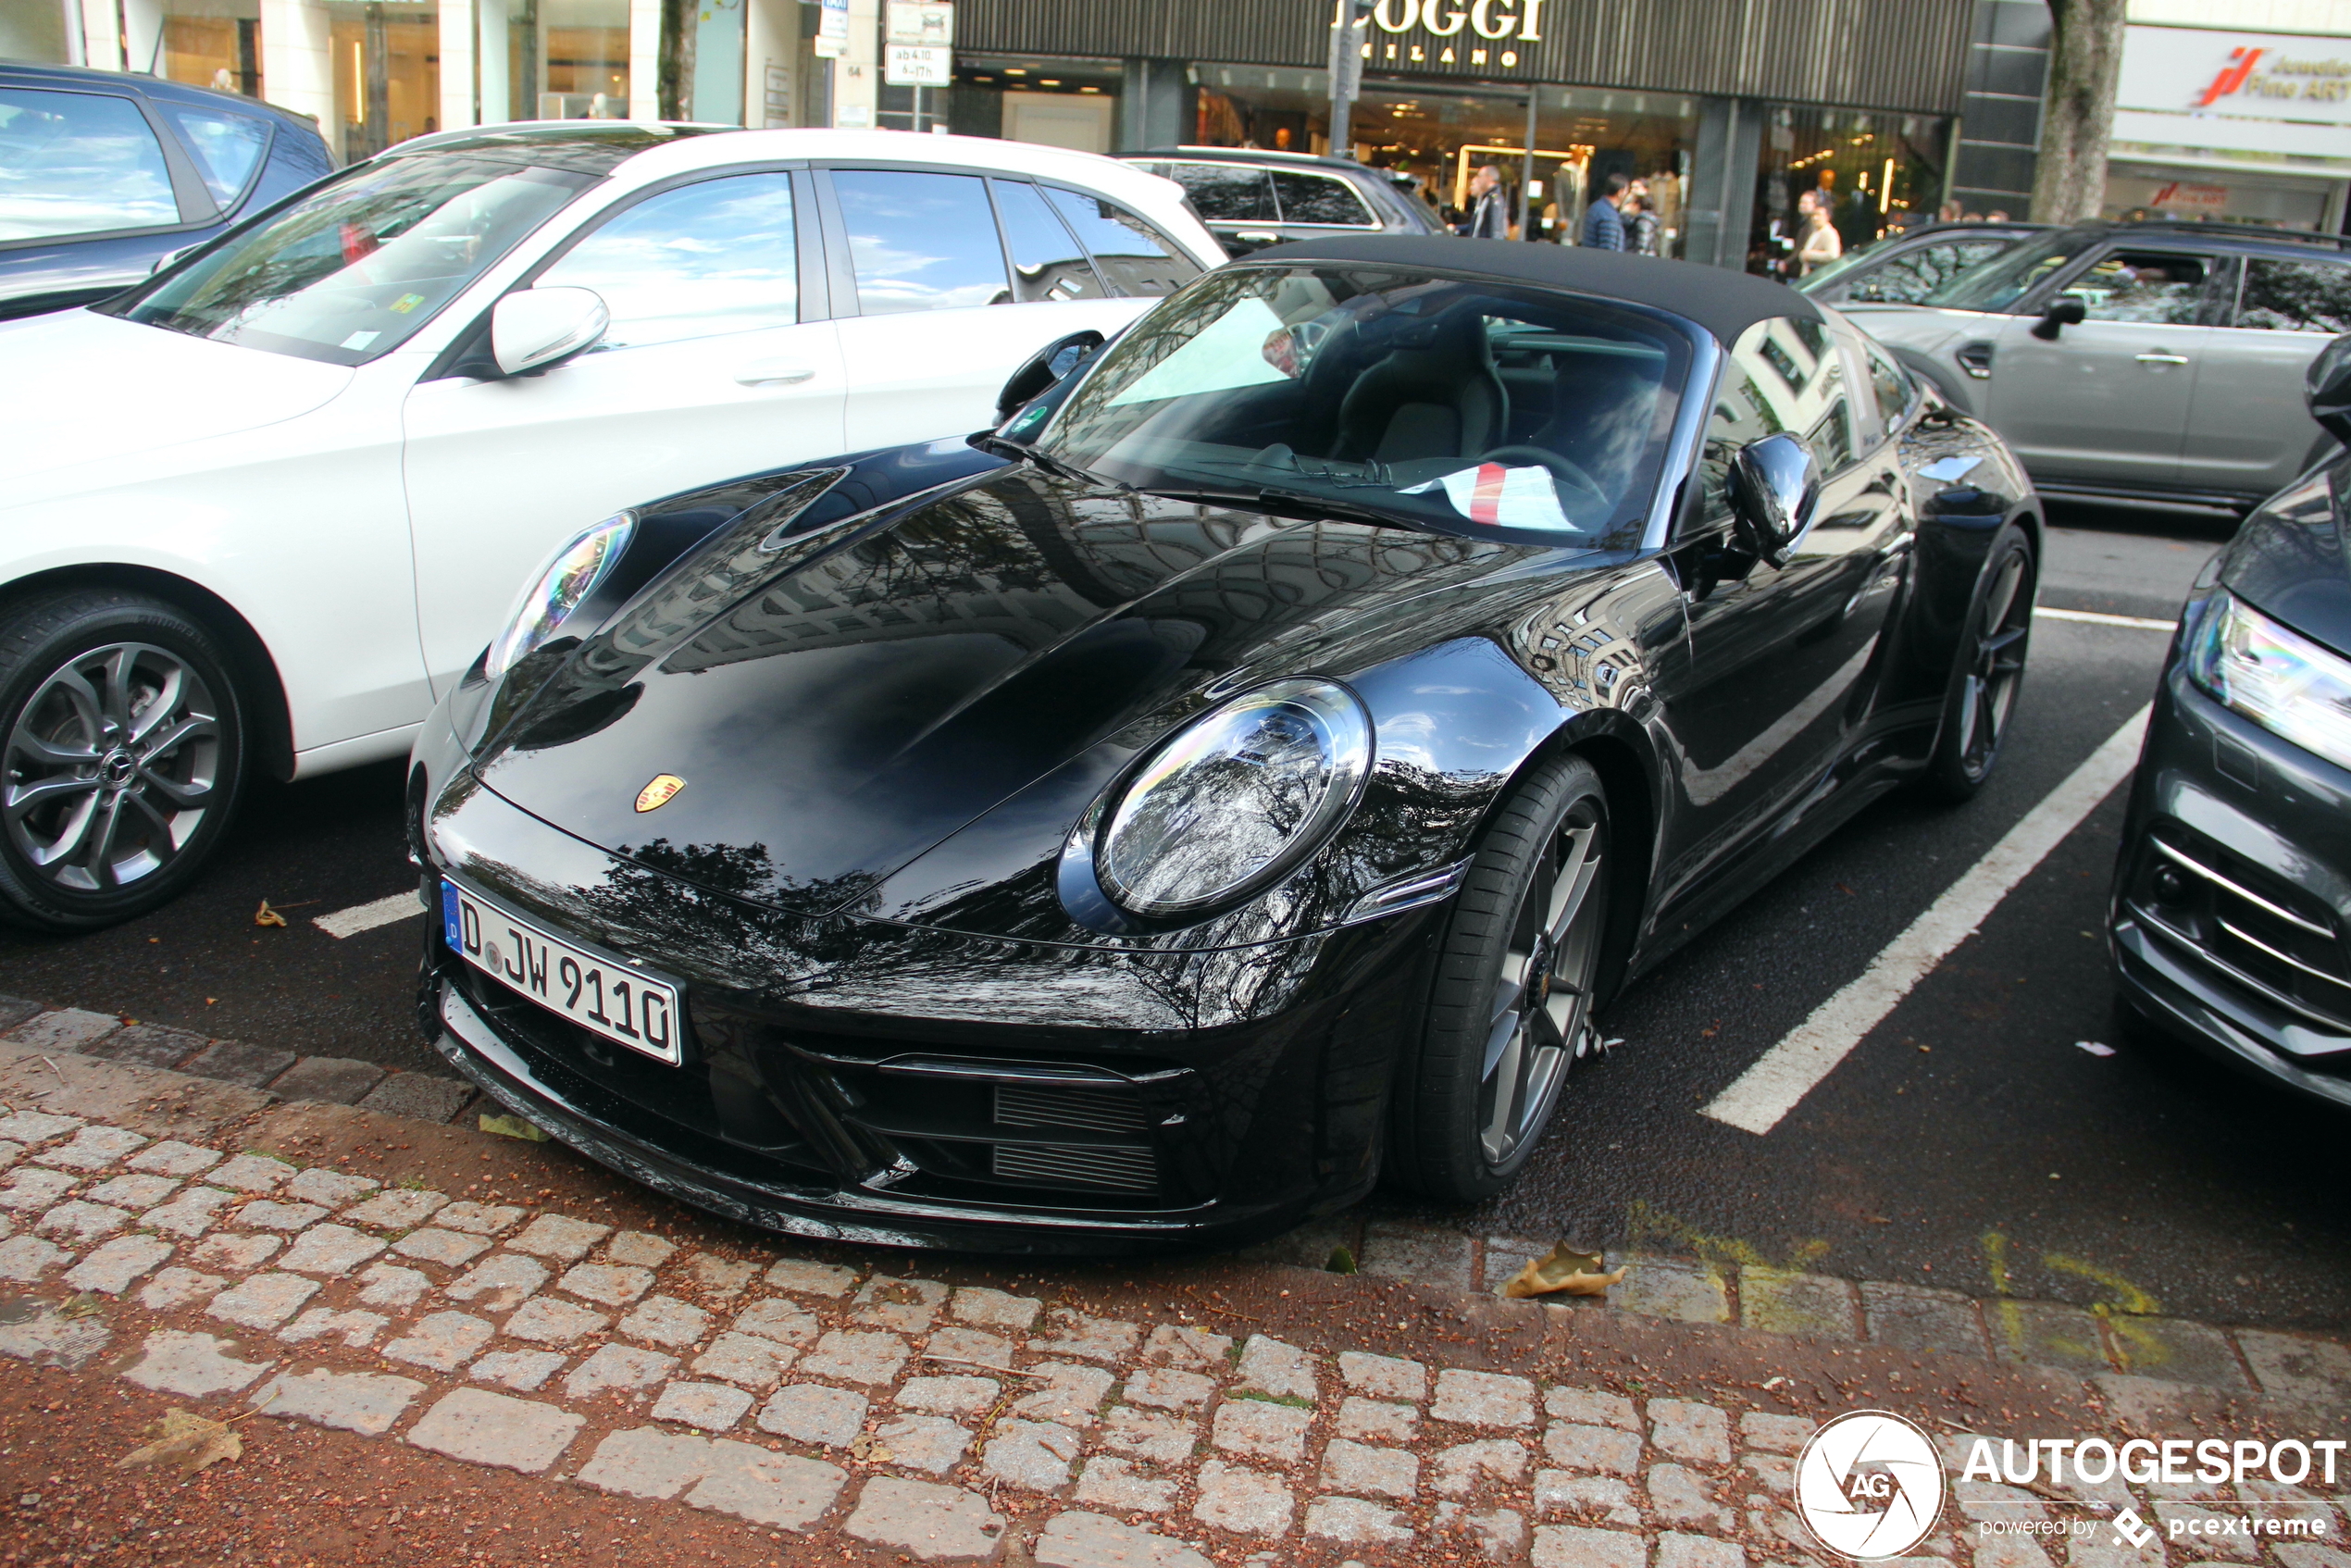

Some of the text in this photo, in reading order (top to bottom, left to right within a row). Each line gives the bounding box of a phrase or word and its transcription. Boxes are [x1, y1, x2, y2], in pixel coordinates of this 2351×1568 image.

[896, 50, 933, 61] ab 4.10.
[450, 923, 457, 939] D
[461, 897, 670, 1050] D JW 9110
